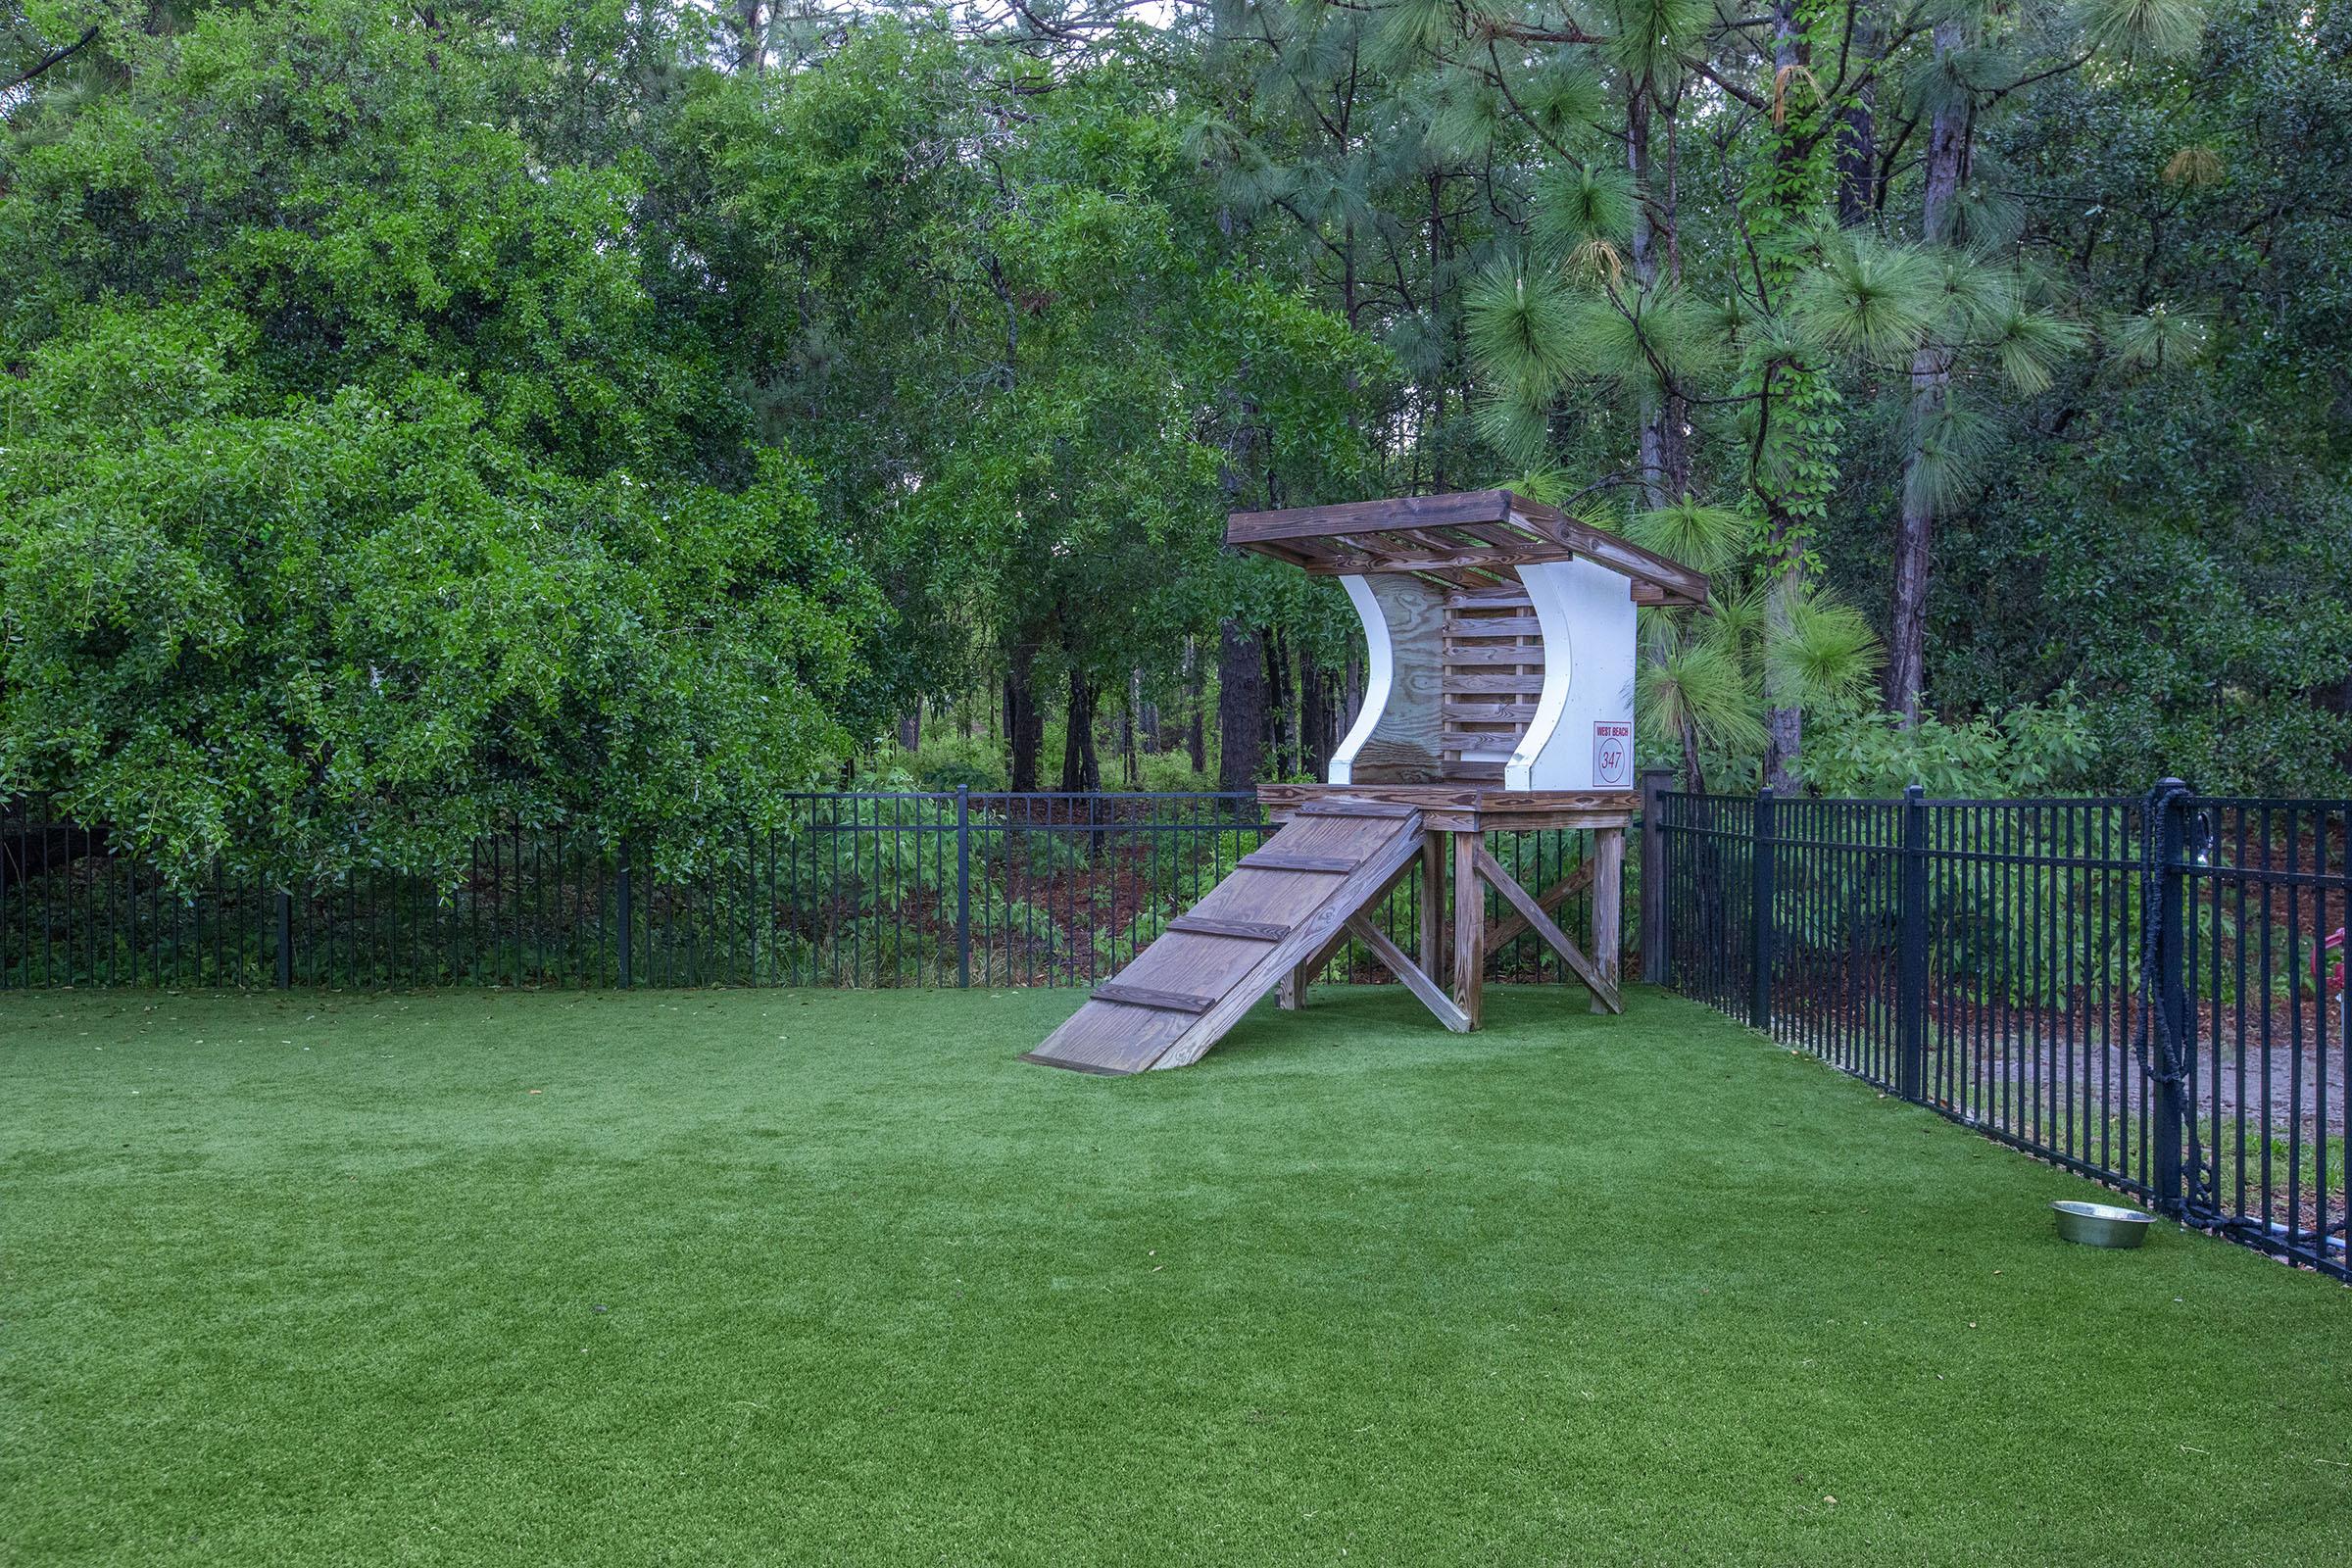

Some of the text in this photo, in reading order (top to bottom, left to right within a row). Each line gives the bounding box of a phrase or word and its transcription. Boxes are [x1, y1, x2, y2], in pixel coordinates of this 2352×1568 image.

[1596, 726, 1629, 736] WEST BEACH
[1601, 751, 1622, 768] 347
